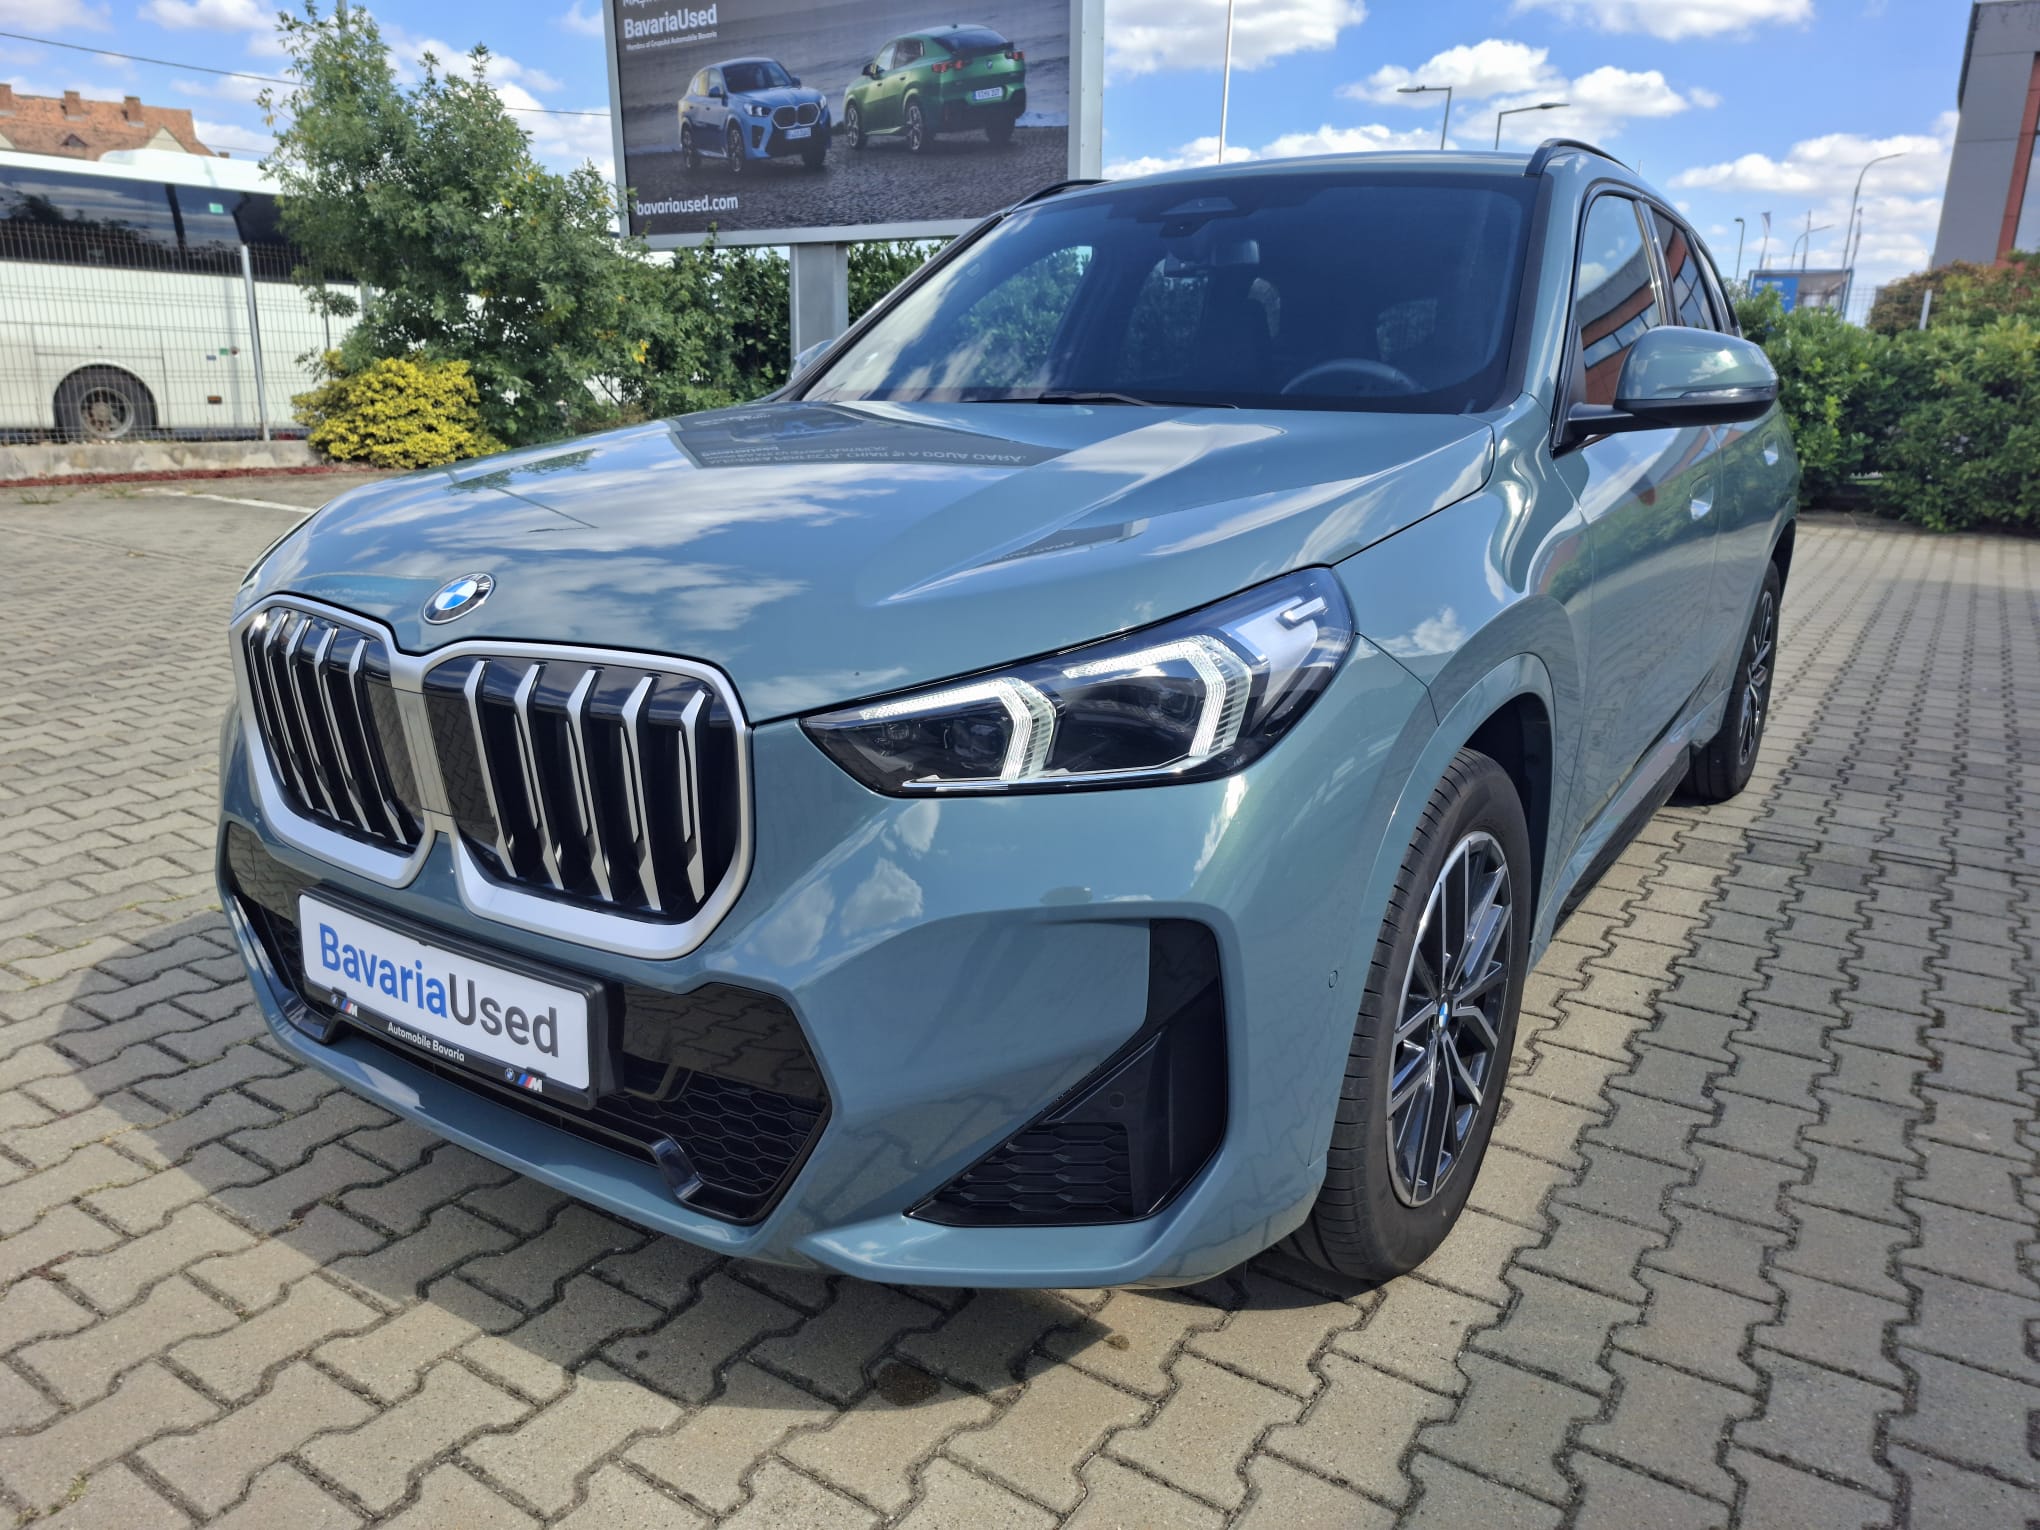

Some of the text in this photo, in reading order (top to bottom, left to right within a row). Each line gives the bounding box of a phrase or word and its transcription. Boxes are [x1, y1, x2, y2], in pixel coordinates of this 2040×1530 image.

[624, 3, 718, 39] BavariaUsed
[636, 194, 738, 216] bavariaused.com
[319, 922, 559, 1057] BavariaUsed
[387, 1022, 465, 1062] Automobile Bavaria
